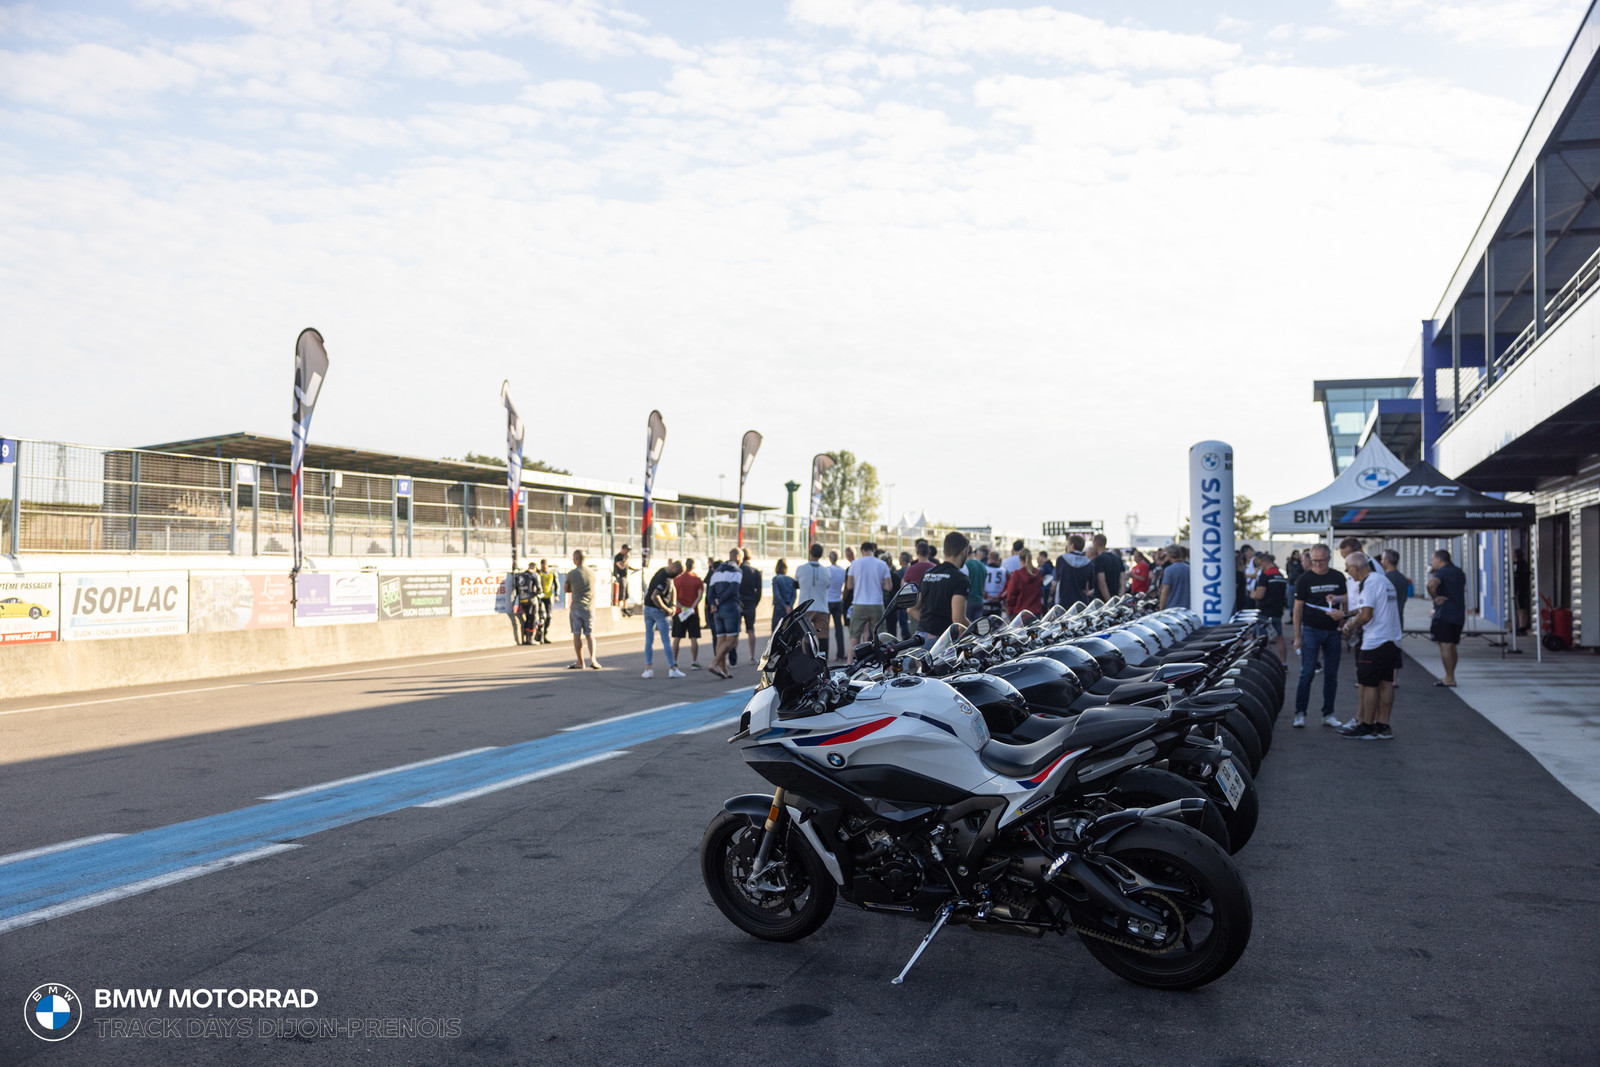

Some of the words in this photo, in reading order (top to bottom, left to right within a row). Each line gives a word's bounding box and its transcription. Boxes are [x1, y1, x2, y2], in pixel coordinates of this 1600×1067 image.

[400, 481, 408, 492] 17
[1395, 485, 1459, 497] BMC
[1294, 510, 1330, 523] BM
[1465, 509, 1523, 519] bmc-moto.com
[1201, 477, 1222, 626] TRACKDAYS
[461, 576, 505, 585] RACE
[987, 570, 1002, 584] 15
[20, 582, 53, 590] PASSAGER
[460, 587, 479, 596] CAR
[482, 586, 506, 595] CLUB
[72, 585, 178, 615] ISOPLAC
